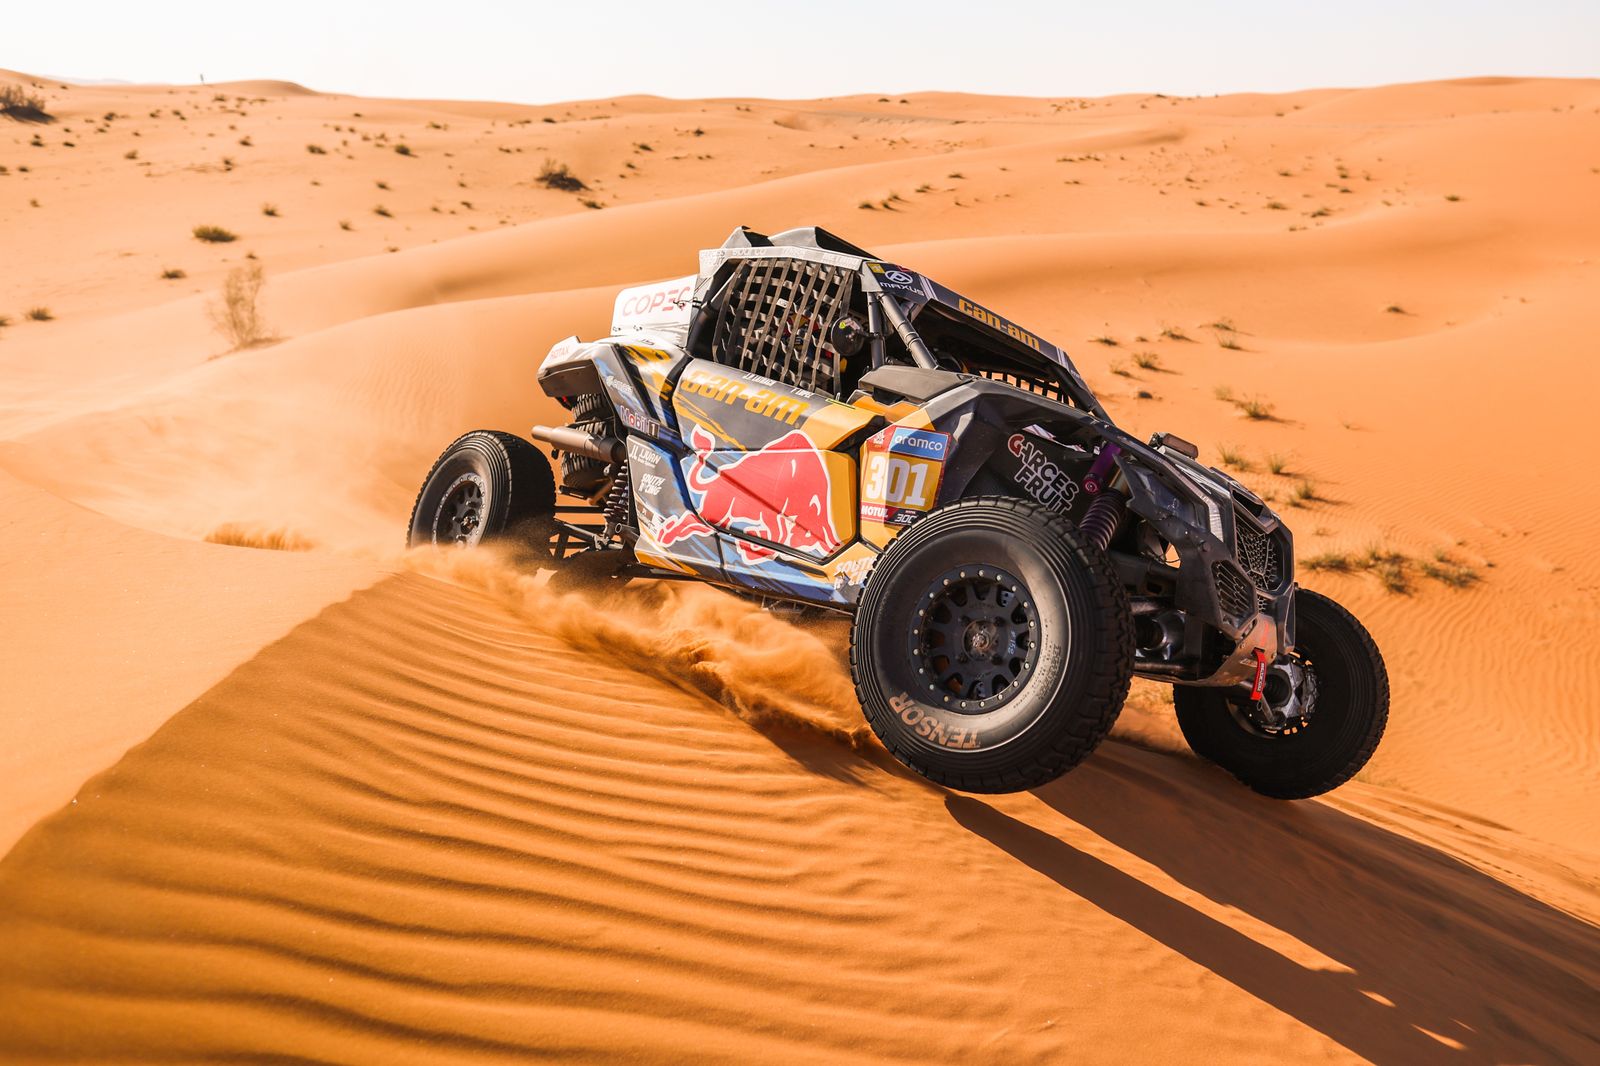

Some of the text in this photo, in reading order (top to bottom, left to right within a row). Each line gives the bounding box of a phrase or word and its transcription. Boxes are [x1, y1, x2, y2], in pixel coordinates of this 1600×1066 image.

[622, 286, 690, 317] COPEC
[880, 281, 924, 297] MAXUS
[959, 298, 1040, 351] can-am
[680, 370, 811, 426] can-am
[620, 405, 650, 435] Mobil
[894, 434, 943, 451] aramco
[642, 473, 666, 487] SOUTH
[866, 455, 929, 507] 301
[1014, 464, 1072, 515] FRUIT
[861, 505, 889, 518] MOTUL
[889, 691, 981, 748] TENSOR
